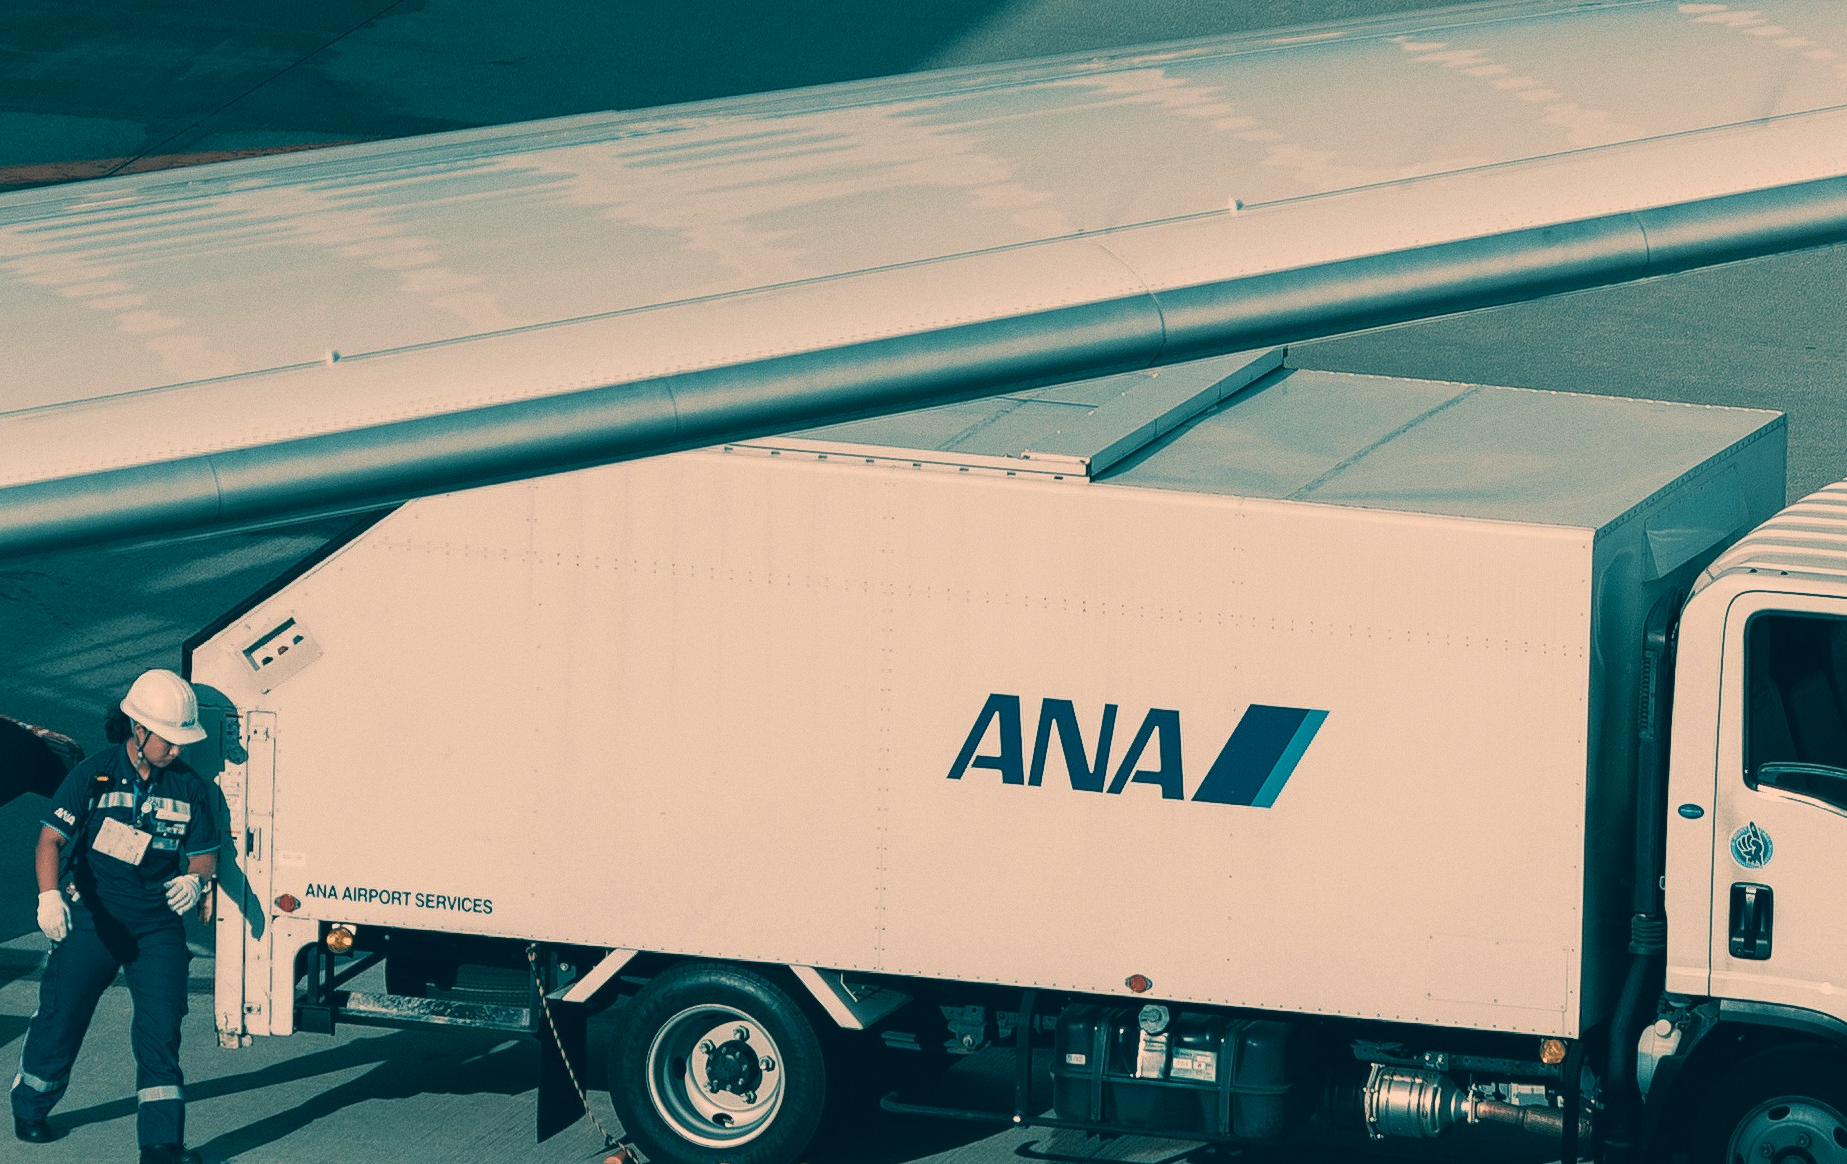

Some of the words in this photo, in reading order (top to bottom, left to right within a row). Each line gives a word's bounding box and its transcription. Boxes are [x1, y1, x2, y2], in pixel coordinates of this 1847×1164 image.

[946, 693, 1185, 801] ANA
[305, 882, 338, 900] ANA
[342, 886, 412, 907] AIRPORT
[415, 892, 493, 915] SERVICES
